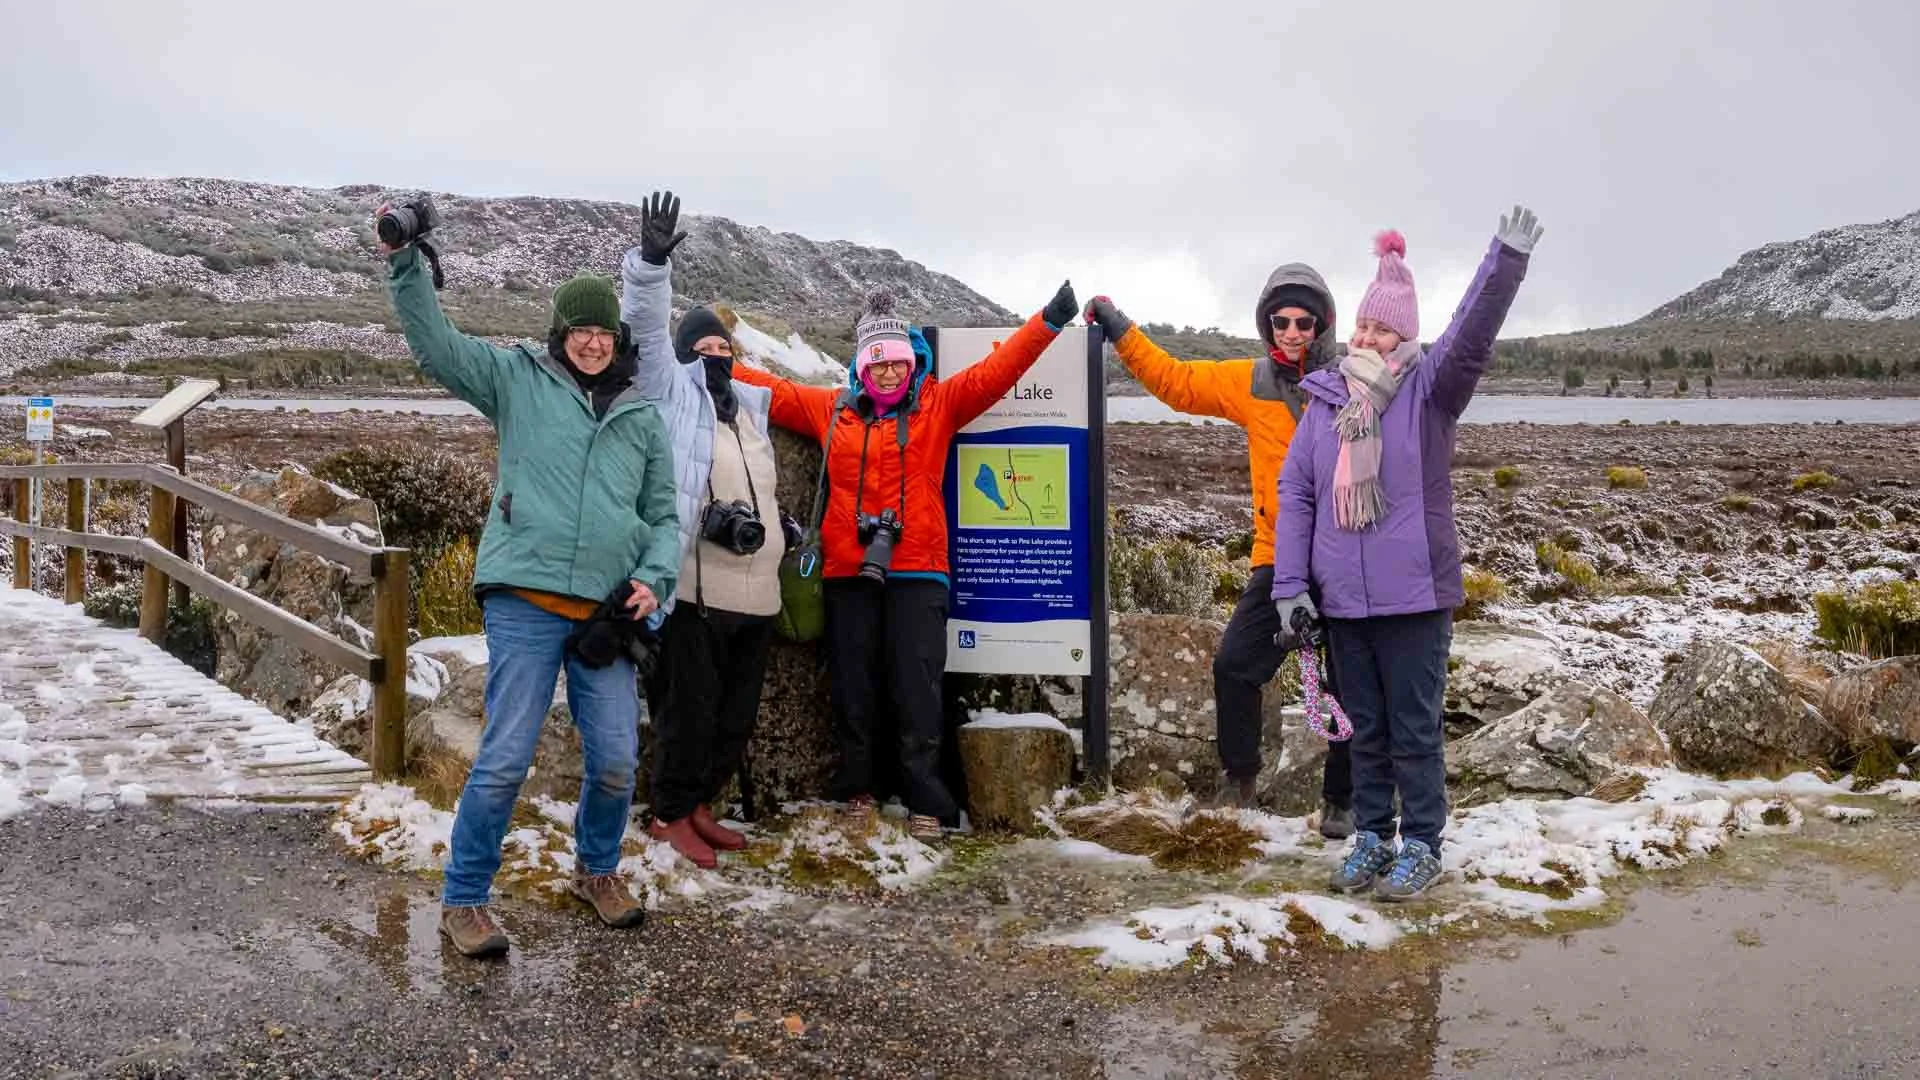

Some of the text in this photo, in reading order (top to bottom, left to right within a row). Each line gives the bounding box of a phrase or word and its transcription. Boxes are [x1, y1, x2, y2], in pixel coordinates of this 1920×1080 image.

[1014, 383, 1053, 400] Lake
[1019, 537, 1030, 545] Pine
[1032, 537, 1043, 545] Lake
[1045, 538, 1067, 546] provides
